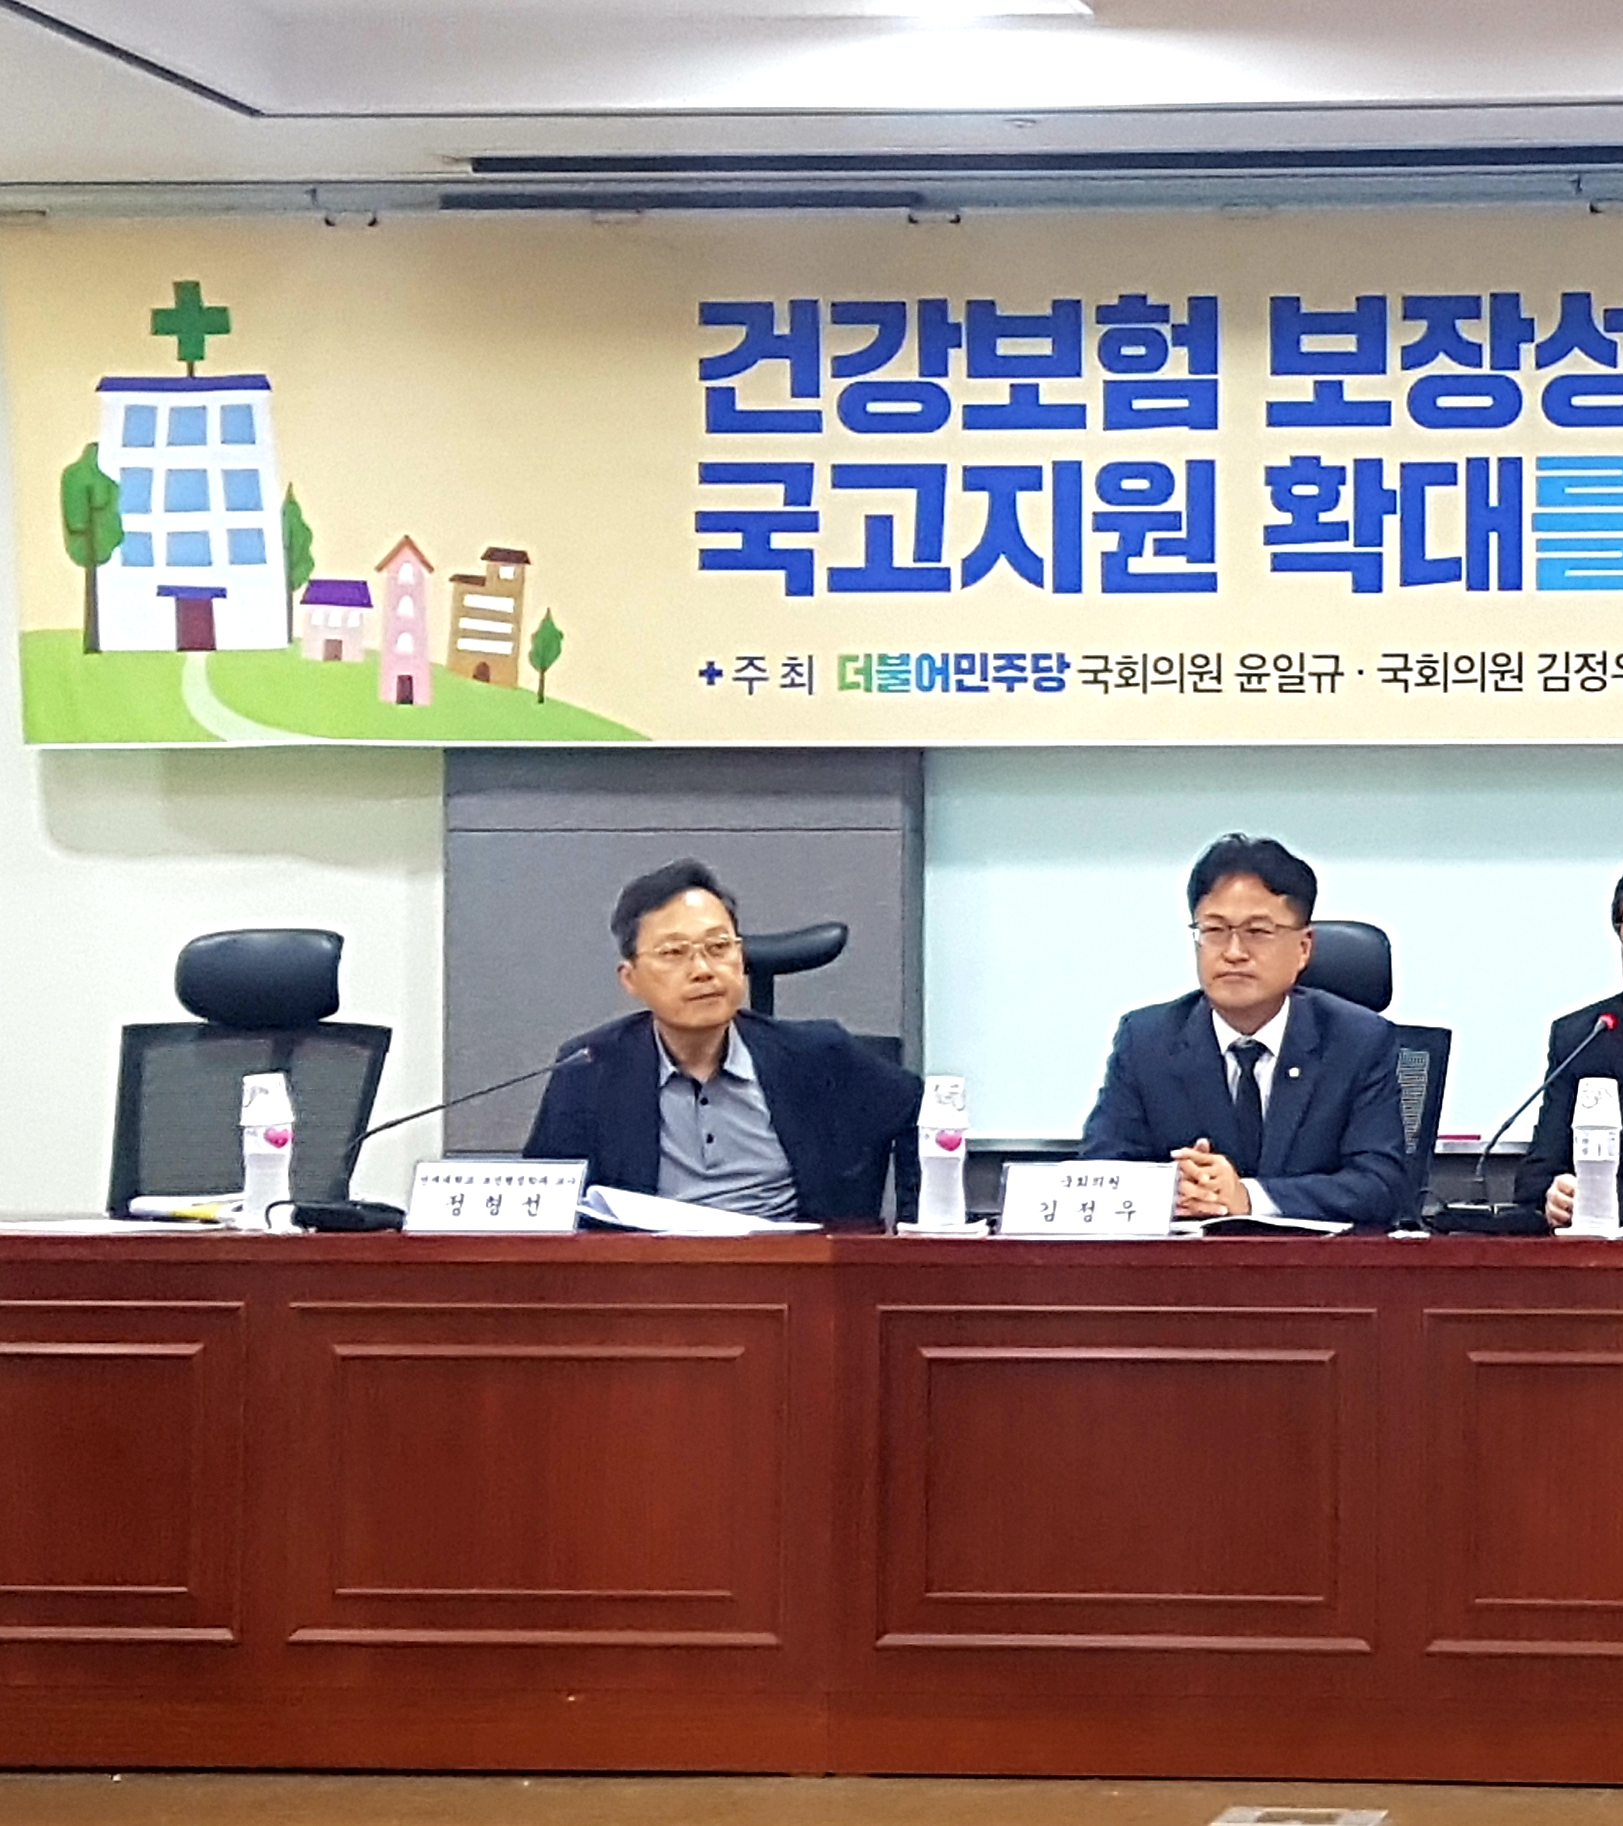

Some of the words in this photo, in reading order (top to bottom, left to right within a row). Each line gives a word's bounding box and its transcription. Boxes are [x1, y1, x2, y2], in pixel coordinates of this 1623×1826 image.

[697, 293, 1219, 434] 건강보험
[695, 459, 1219, 597] 국고지원
[836, 652, 1071, 695] 더불어민주당
[1076, 653, 1224, 695] 국회의원
[1233, 653, 1345, 695] 윤일규
[1376, 650, 1525, 694] 국회의원
